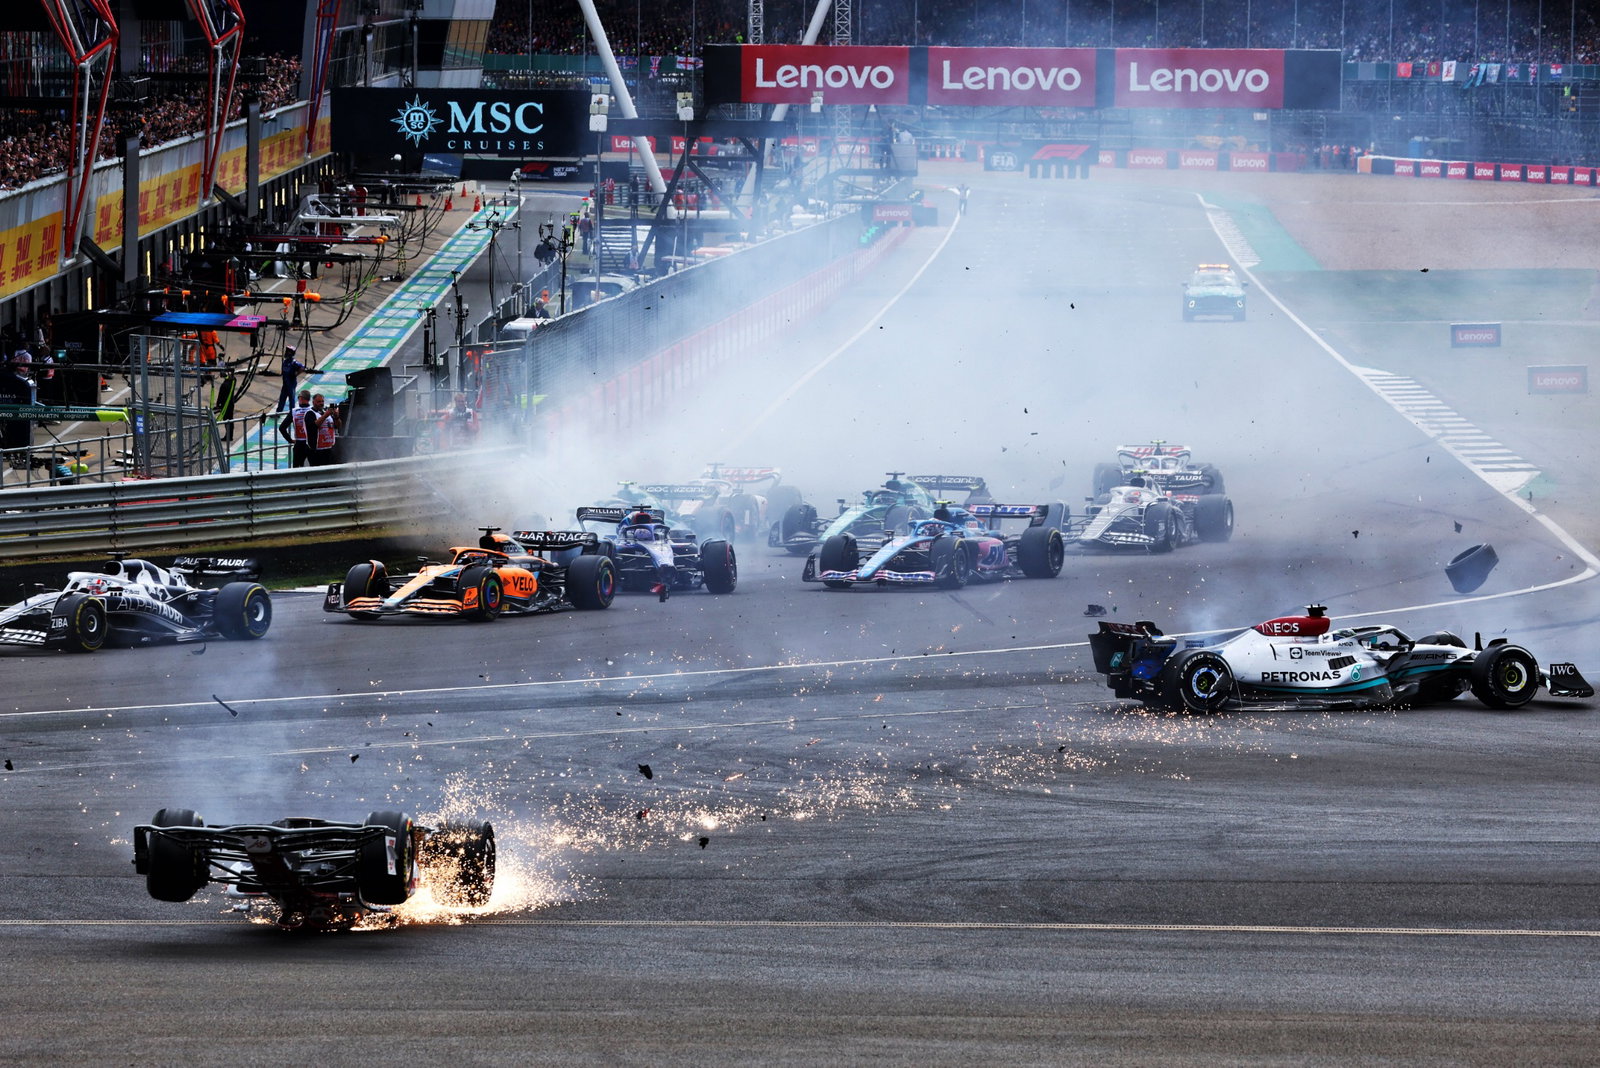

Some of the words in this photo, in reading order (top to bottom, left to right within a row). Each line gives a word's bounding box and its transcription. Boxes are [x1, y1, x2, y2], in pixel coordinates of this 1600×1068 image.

[755, 57, 895, 89] Lenovo
[942, 59, 1081, 91] Lenovo
[1129, 61, 1270, 93] Lenovo
[447, 101, 544, 135] MSC
[447, 140, 545, 150] CRUISES
[673, 139, 698, 150] Leo
[991, 155, 1015, 167] FIA
[1130, 154, 1164, 165] Lenovo
[1181, 155, 1214, 166] Lenovo
[1233, 156, 1266, 168] Lenovo
[876, 208, 910, 217] Lenovo
[1459, 332, 1494, 341] Lenovo
[1536, 376, 1578, 386] Lenovo
[512, 576, 534, 592] VELO
[51, 617, 69, 629] ZIBA
[1260, 622, 1300, 633] INEOS
[1261, 670, 1342, 682] PETRONAS
[1551, 665, 1576, 676] IWC
